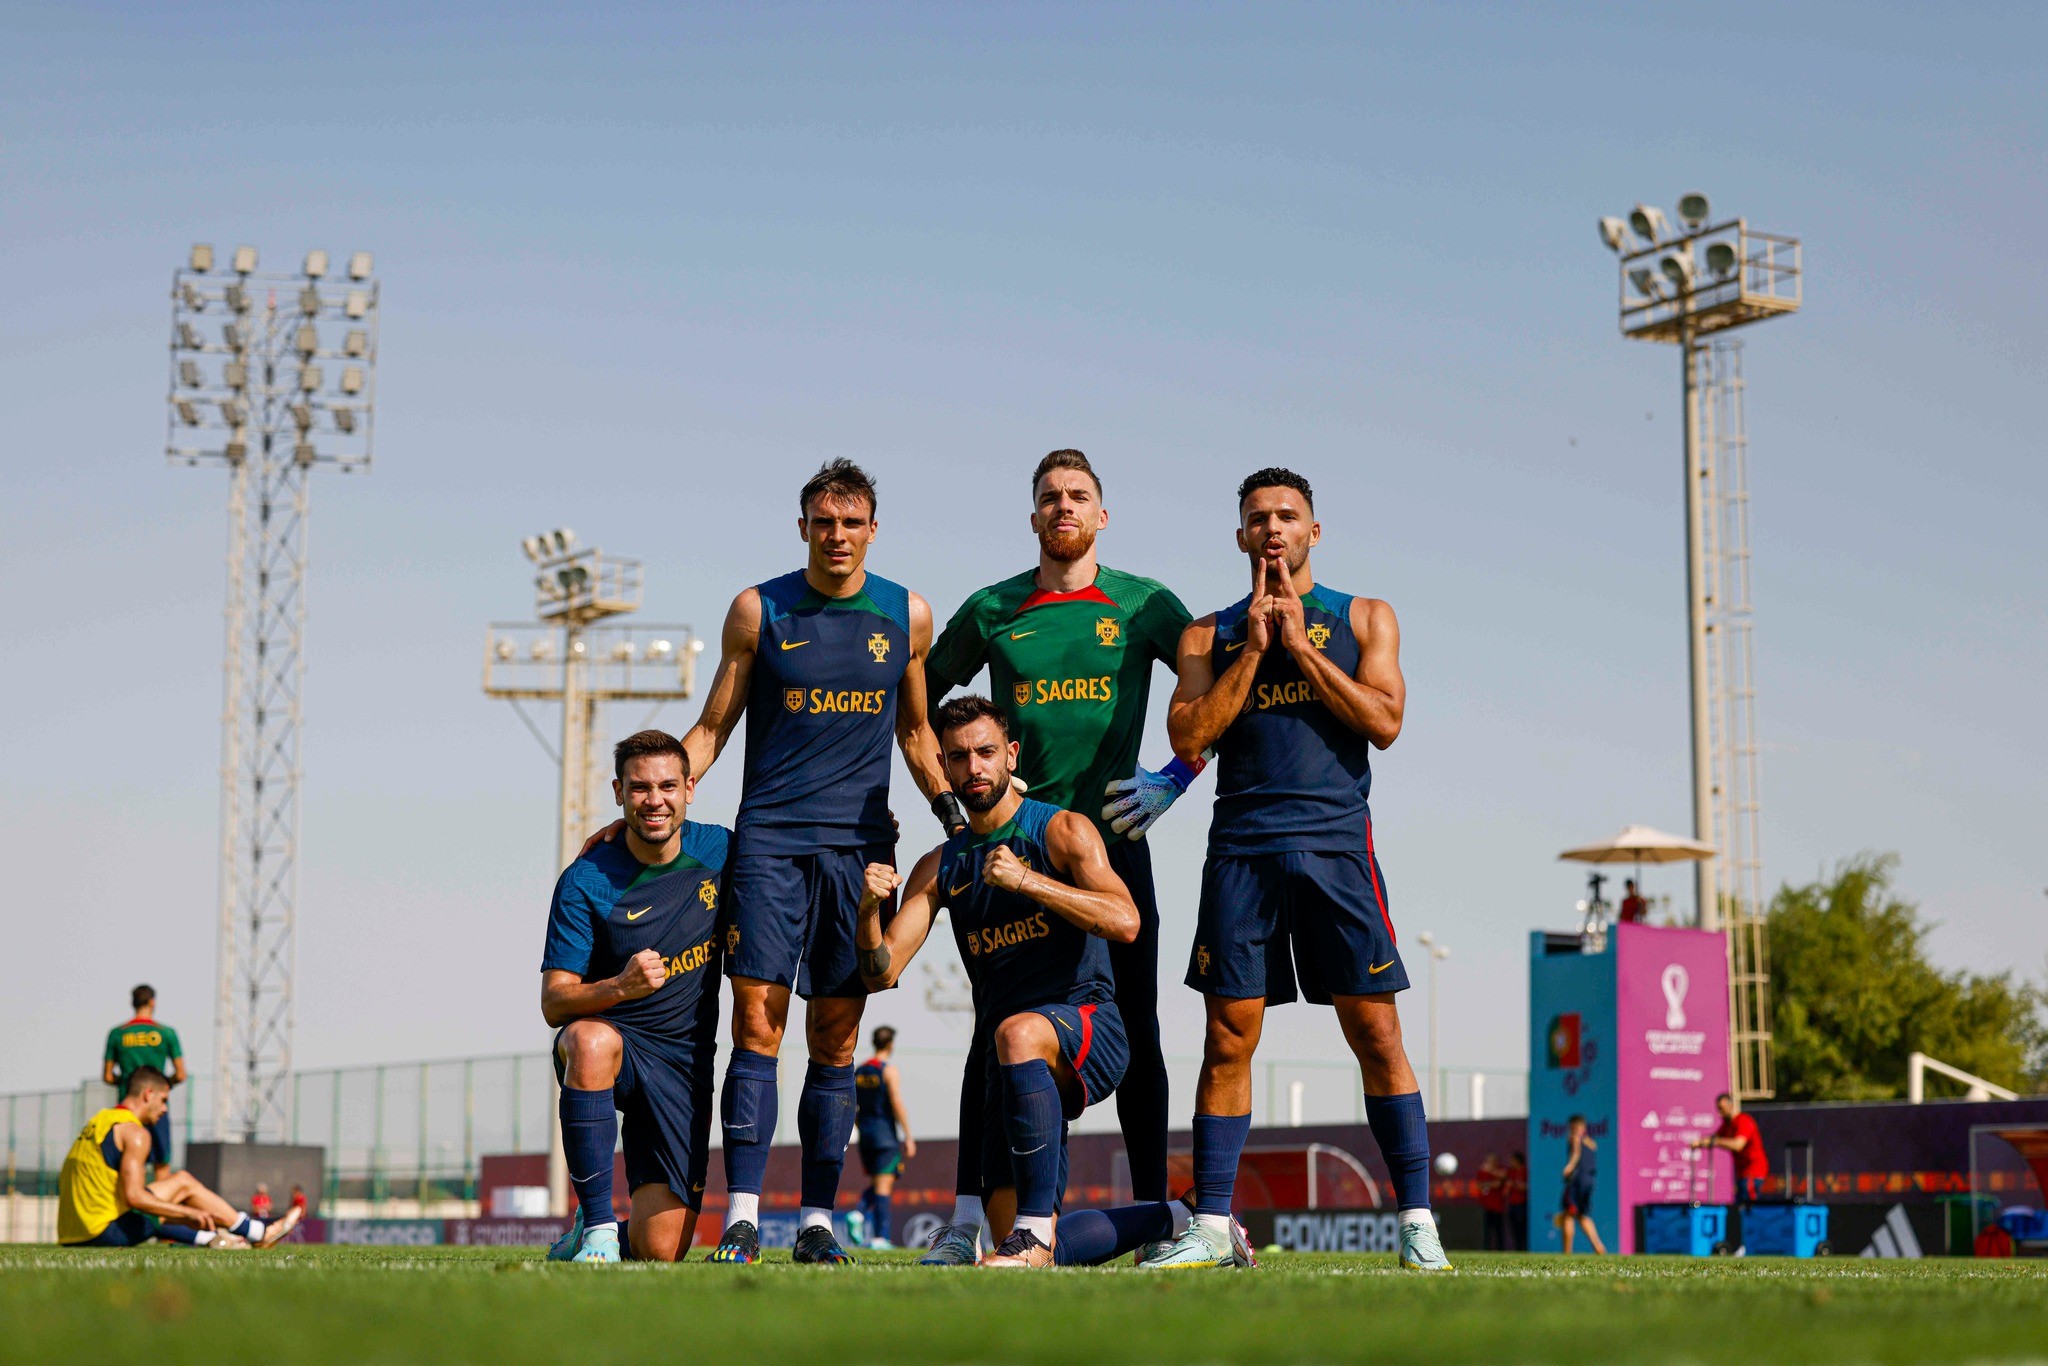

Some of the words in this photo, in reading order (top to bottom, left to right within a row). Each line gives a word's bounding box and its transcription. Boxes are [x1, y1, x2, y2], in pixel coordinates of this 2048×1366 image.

[809, 688, 886, 714] SAGRES
[1036, 676, 1111, 705] SAGRES
[1257, 681, 1321, 710] SAGR
[981, 911, 1049, 954] SAGRES
[1274, 1214, 1441, 1251] POWERA
